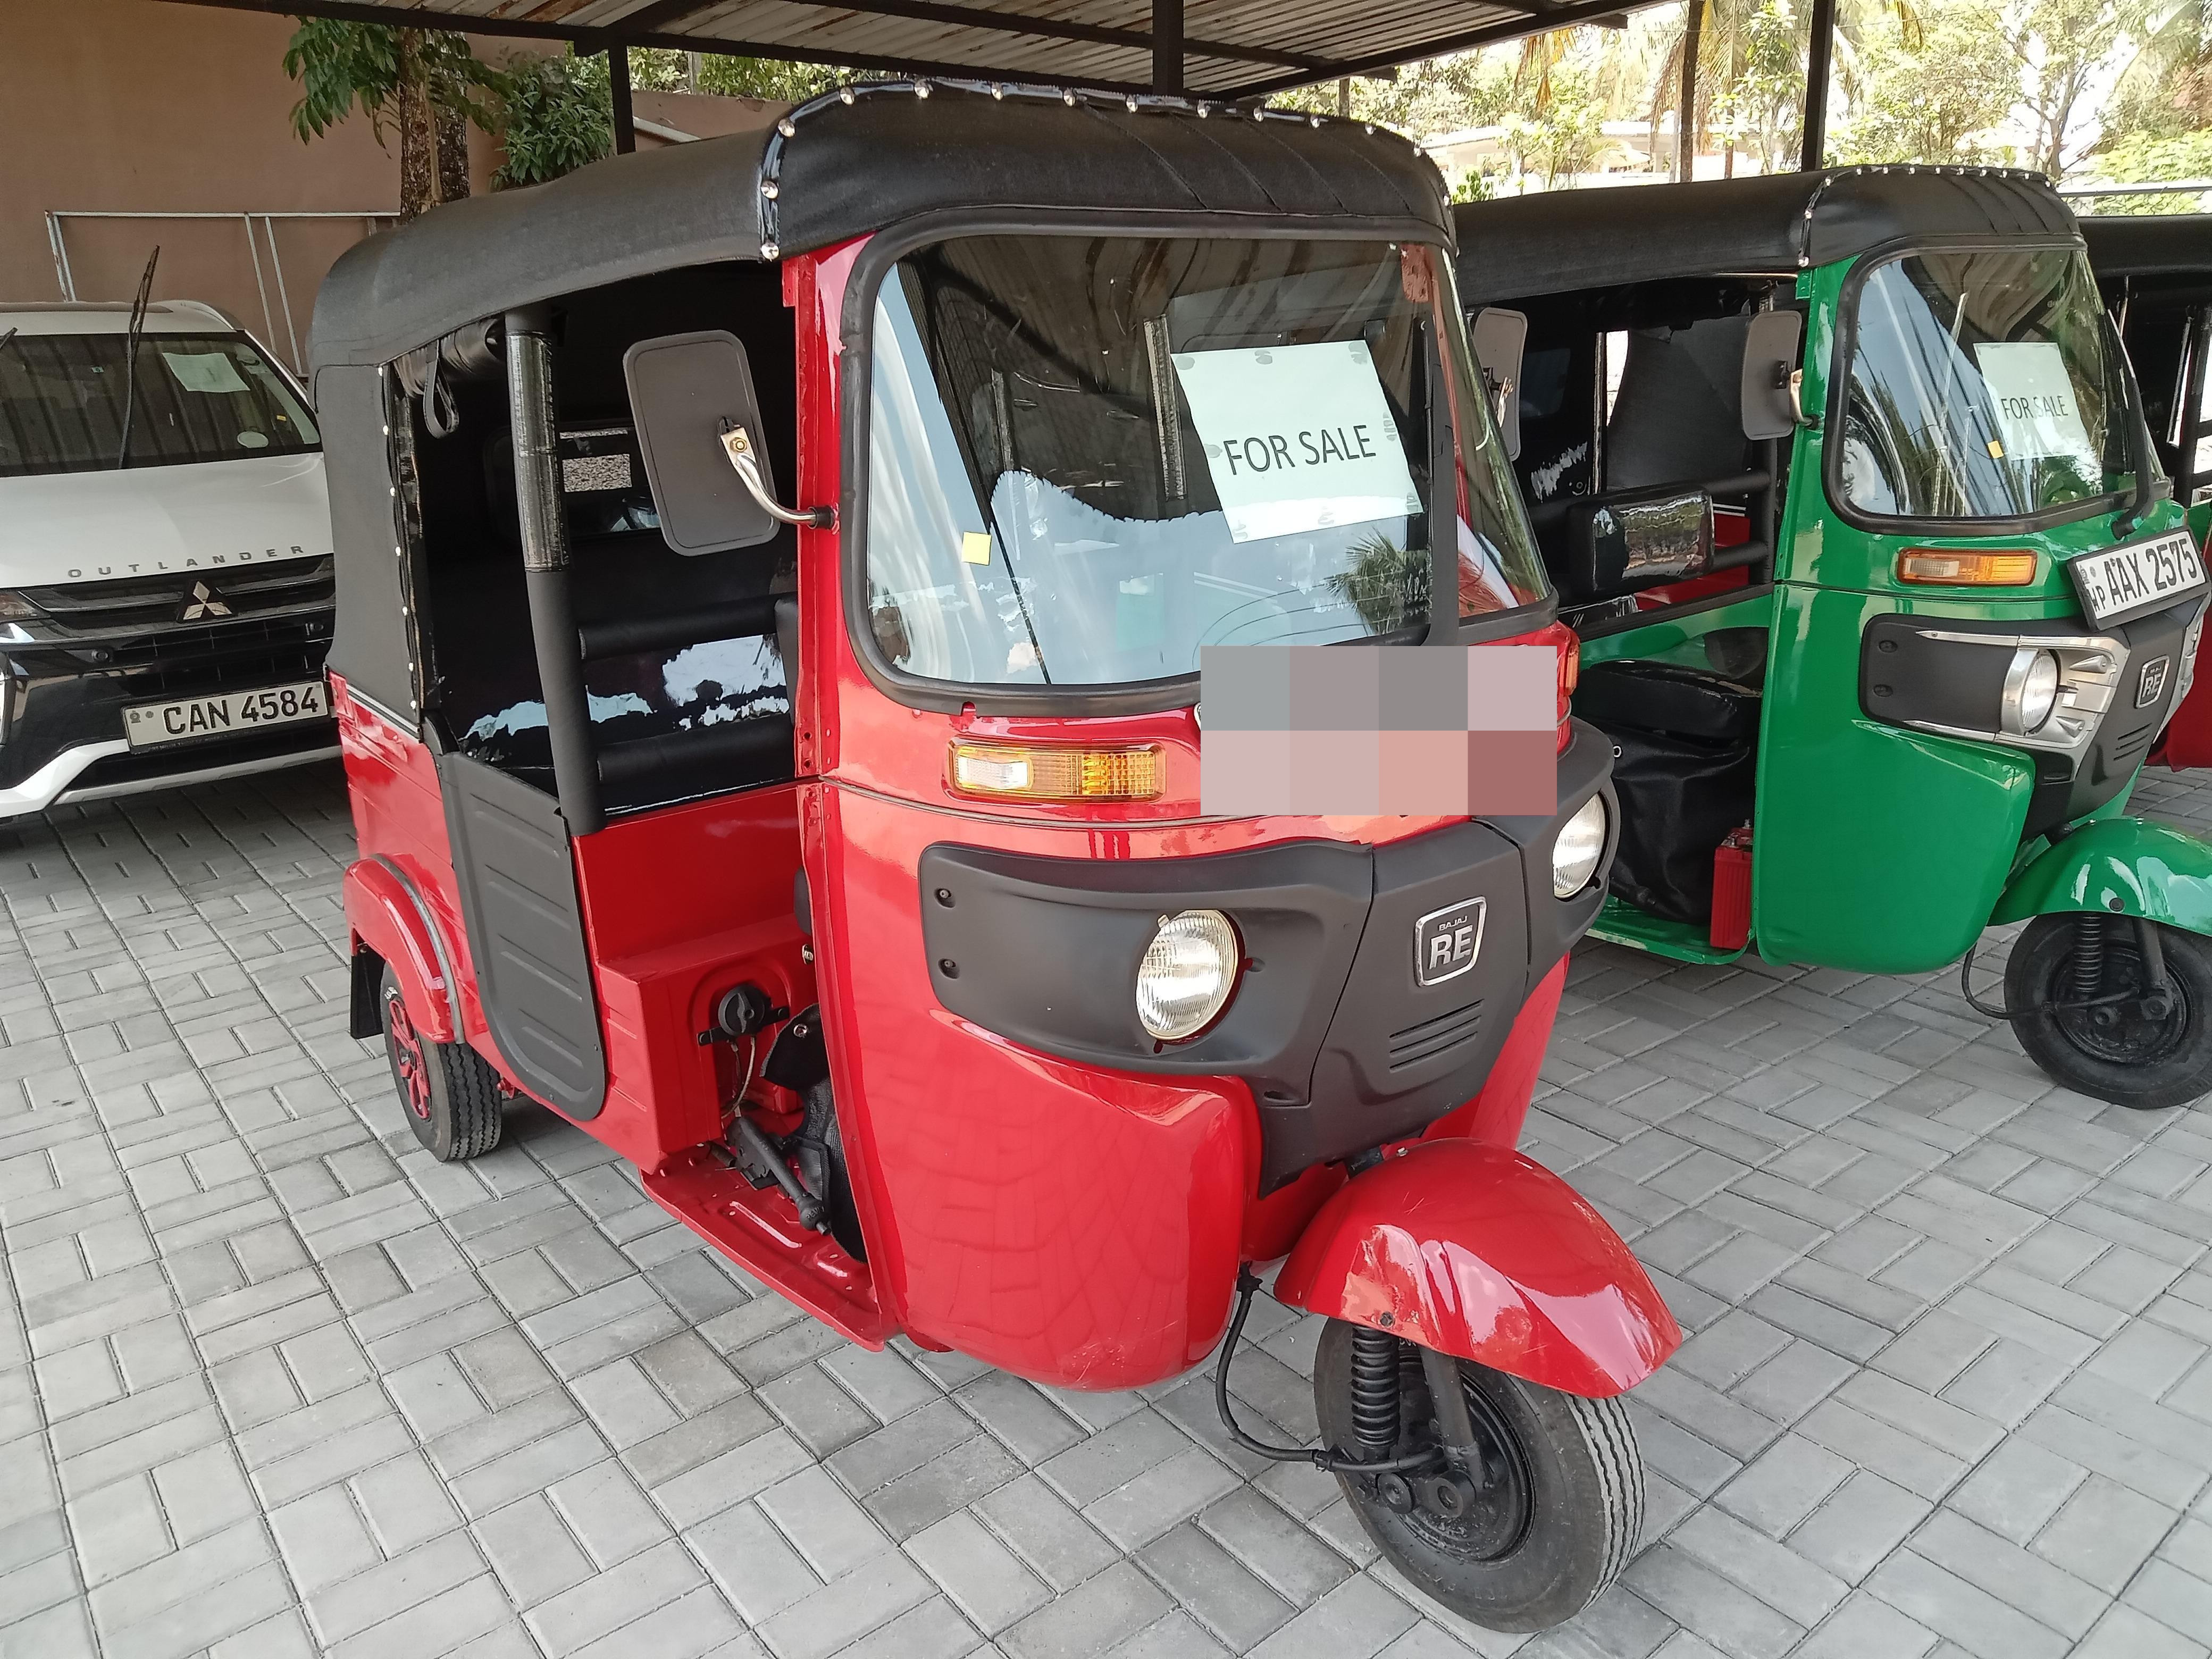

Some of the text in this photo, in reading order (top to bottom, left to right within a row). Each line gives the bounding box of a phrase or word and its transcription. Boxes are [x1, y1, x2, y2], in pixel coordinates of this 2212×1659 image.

[2001, 395, 2068, 420] FOR SALE
[1223, 425, 1376, 475] FOR SALE
[68, 545, 304, 578] OUTLANDER
[2104, 538, 2197, 606] AAX 2575
[2141, 672, 2162, 698] RE
[163, 686, 319, 735] CAN 4584
[1438, 916, 1468, 931] BAJAJ
[1428, 925, 1473, 970] RE
